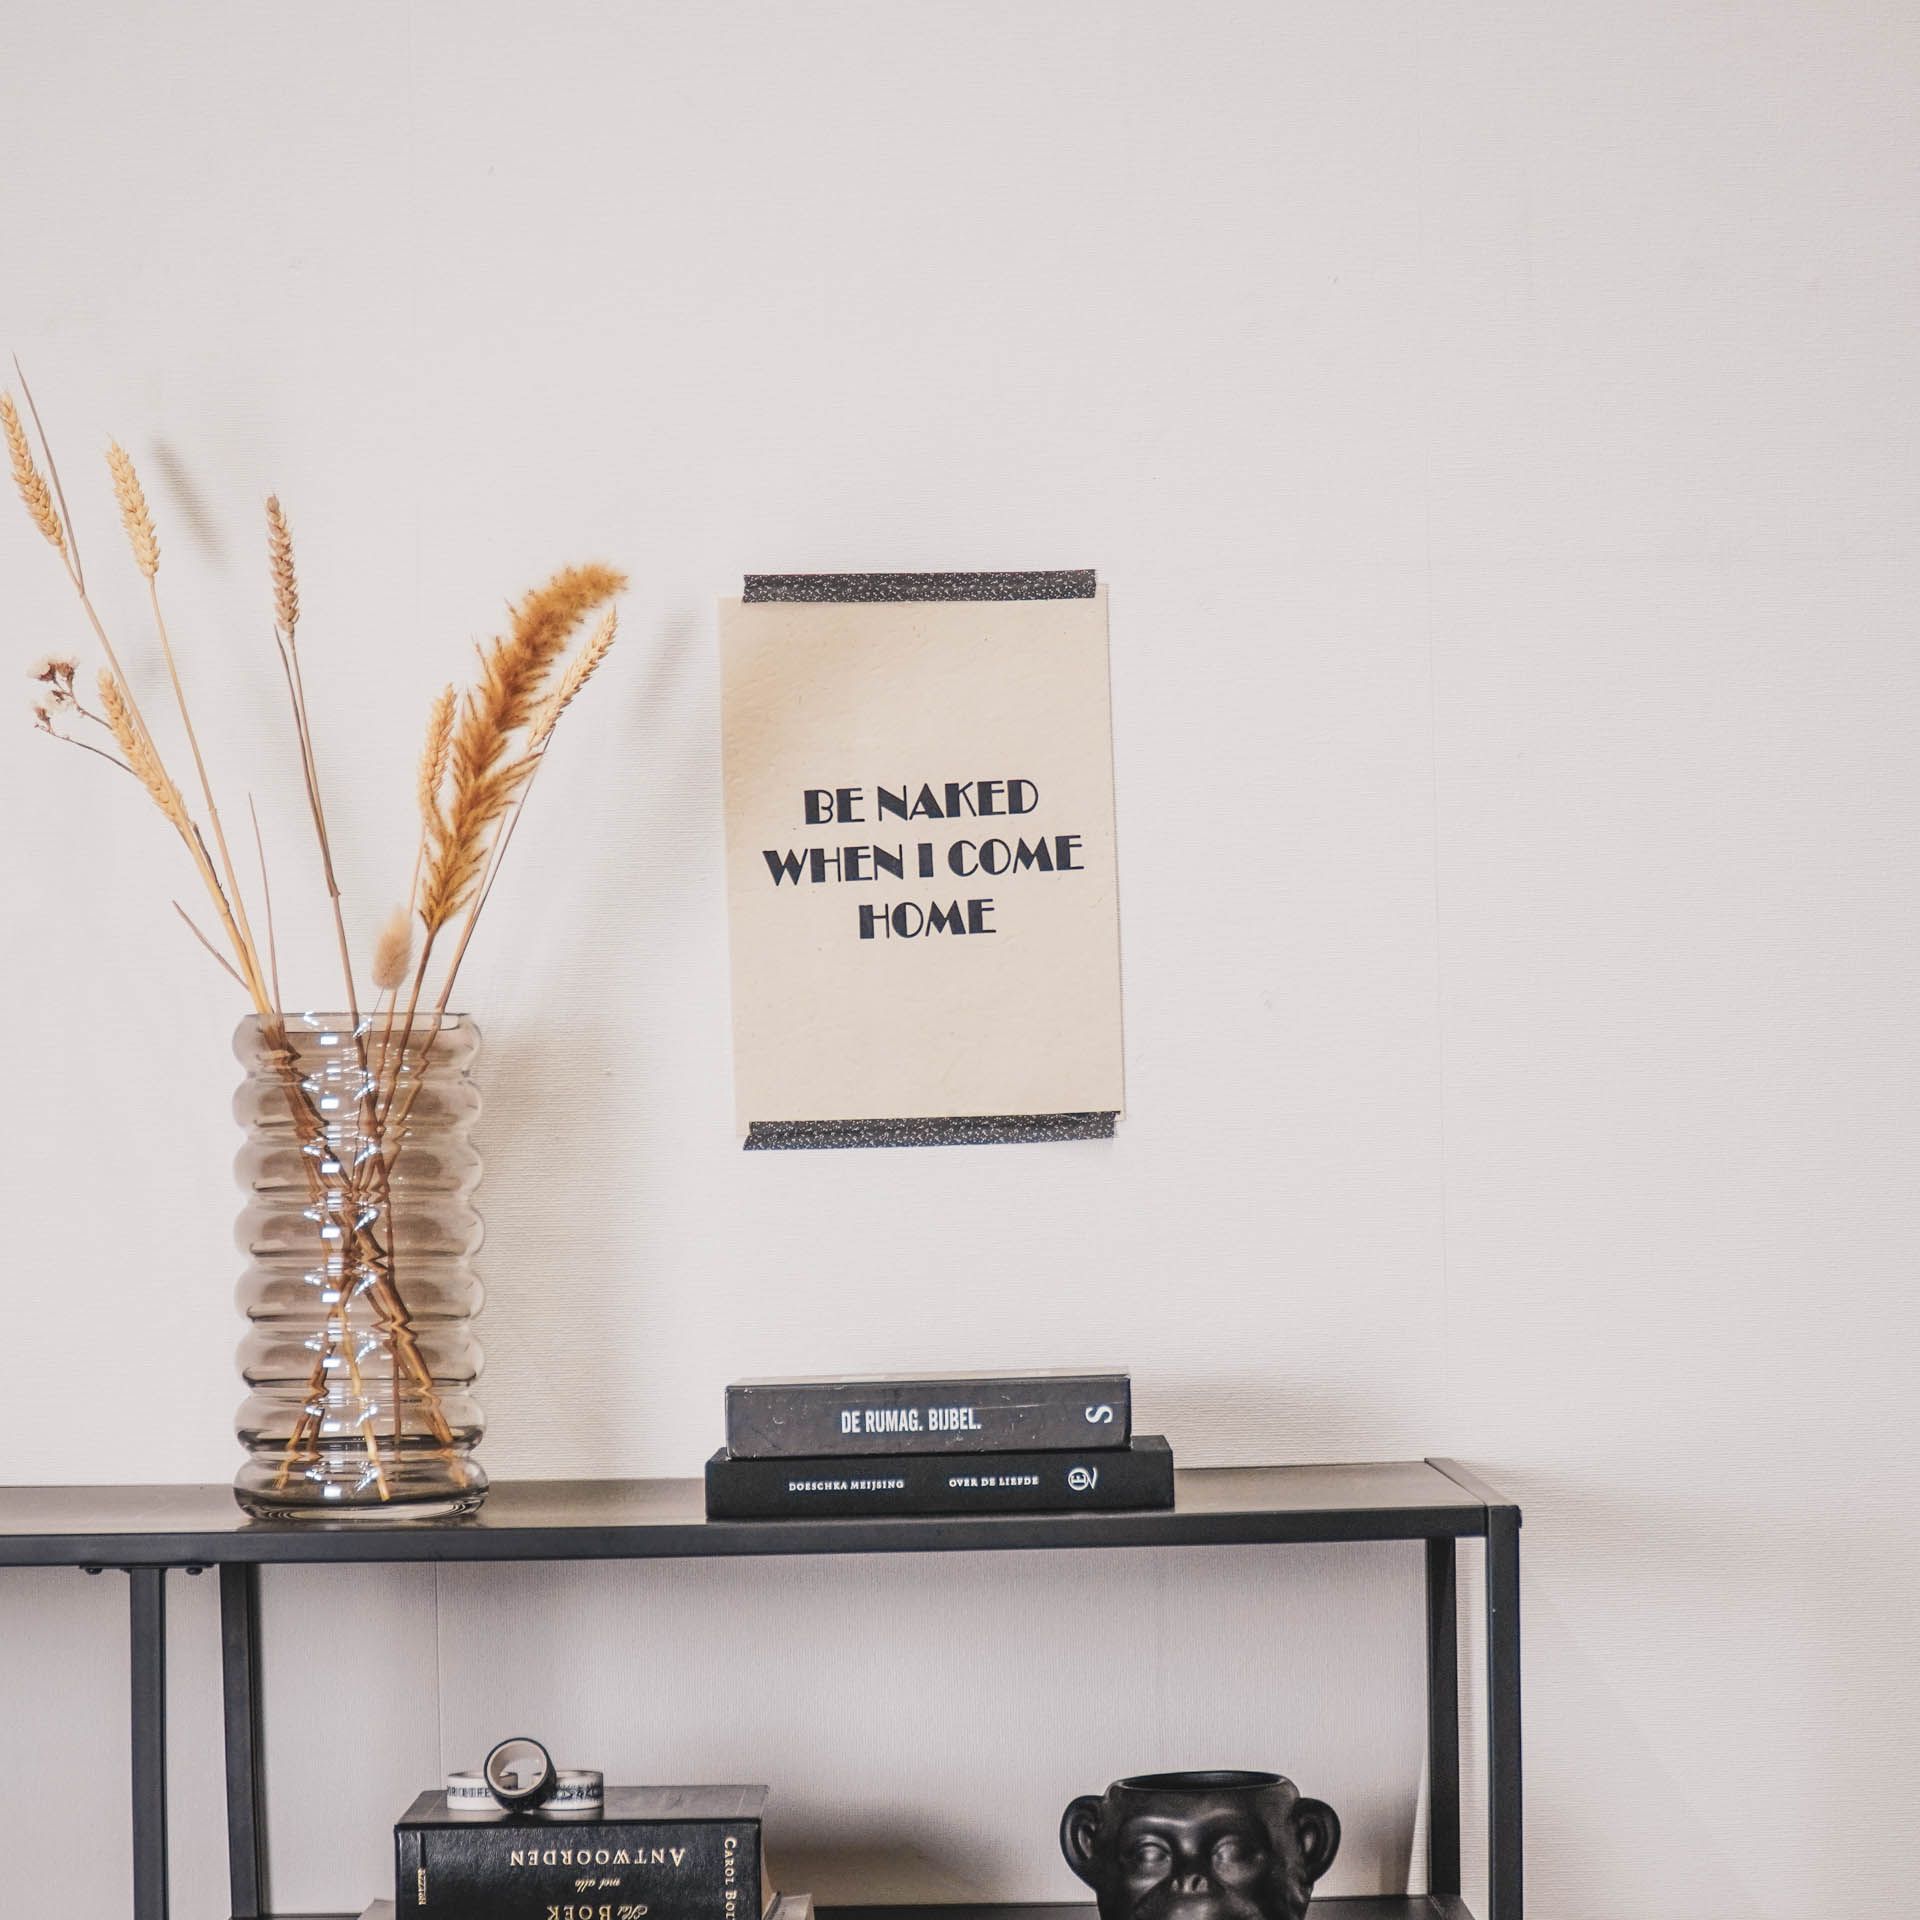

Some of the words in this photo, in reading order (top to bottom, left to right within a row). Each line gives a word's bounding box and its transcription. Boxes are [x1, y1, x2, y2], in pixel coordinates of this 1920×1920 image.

[804, 787, 865, 824] BE
[877, 779, 1039, 821] NAKED
[763, 844, 904, 886] WHEN
[918, 843, 934, 878] I
[948, 835, 1084, 877] COME
[859, 899, 996, 939] HOME
[841, 1410, 860, 1433] DE
[865, 1408, 924, 1432] RUMAG.
[928, 1407, 982, 1431] BIJBEL.
[788, 1480, 848, 1491] DOESCHKA
[850, 1479, 905, 1491] MEIJSING
[949, 1477, 978, 1487] OVER
[980, 1476, 996, 1487] DE
[998, 1475, 1040, 1486] LIEFDE
[510, 1847, 686, 1867] ANTWOORDEN
[724, 1836, 738, 1886] CAROL
[546, 1904, 612, 1920] BOEK
[725, 1889, 738, 1920] BOL
